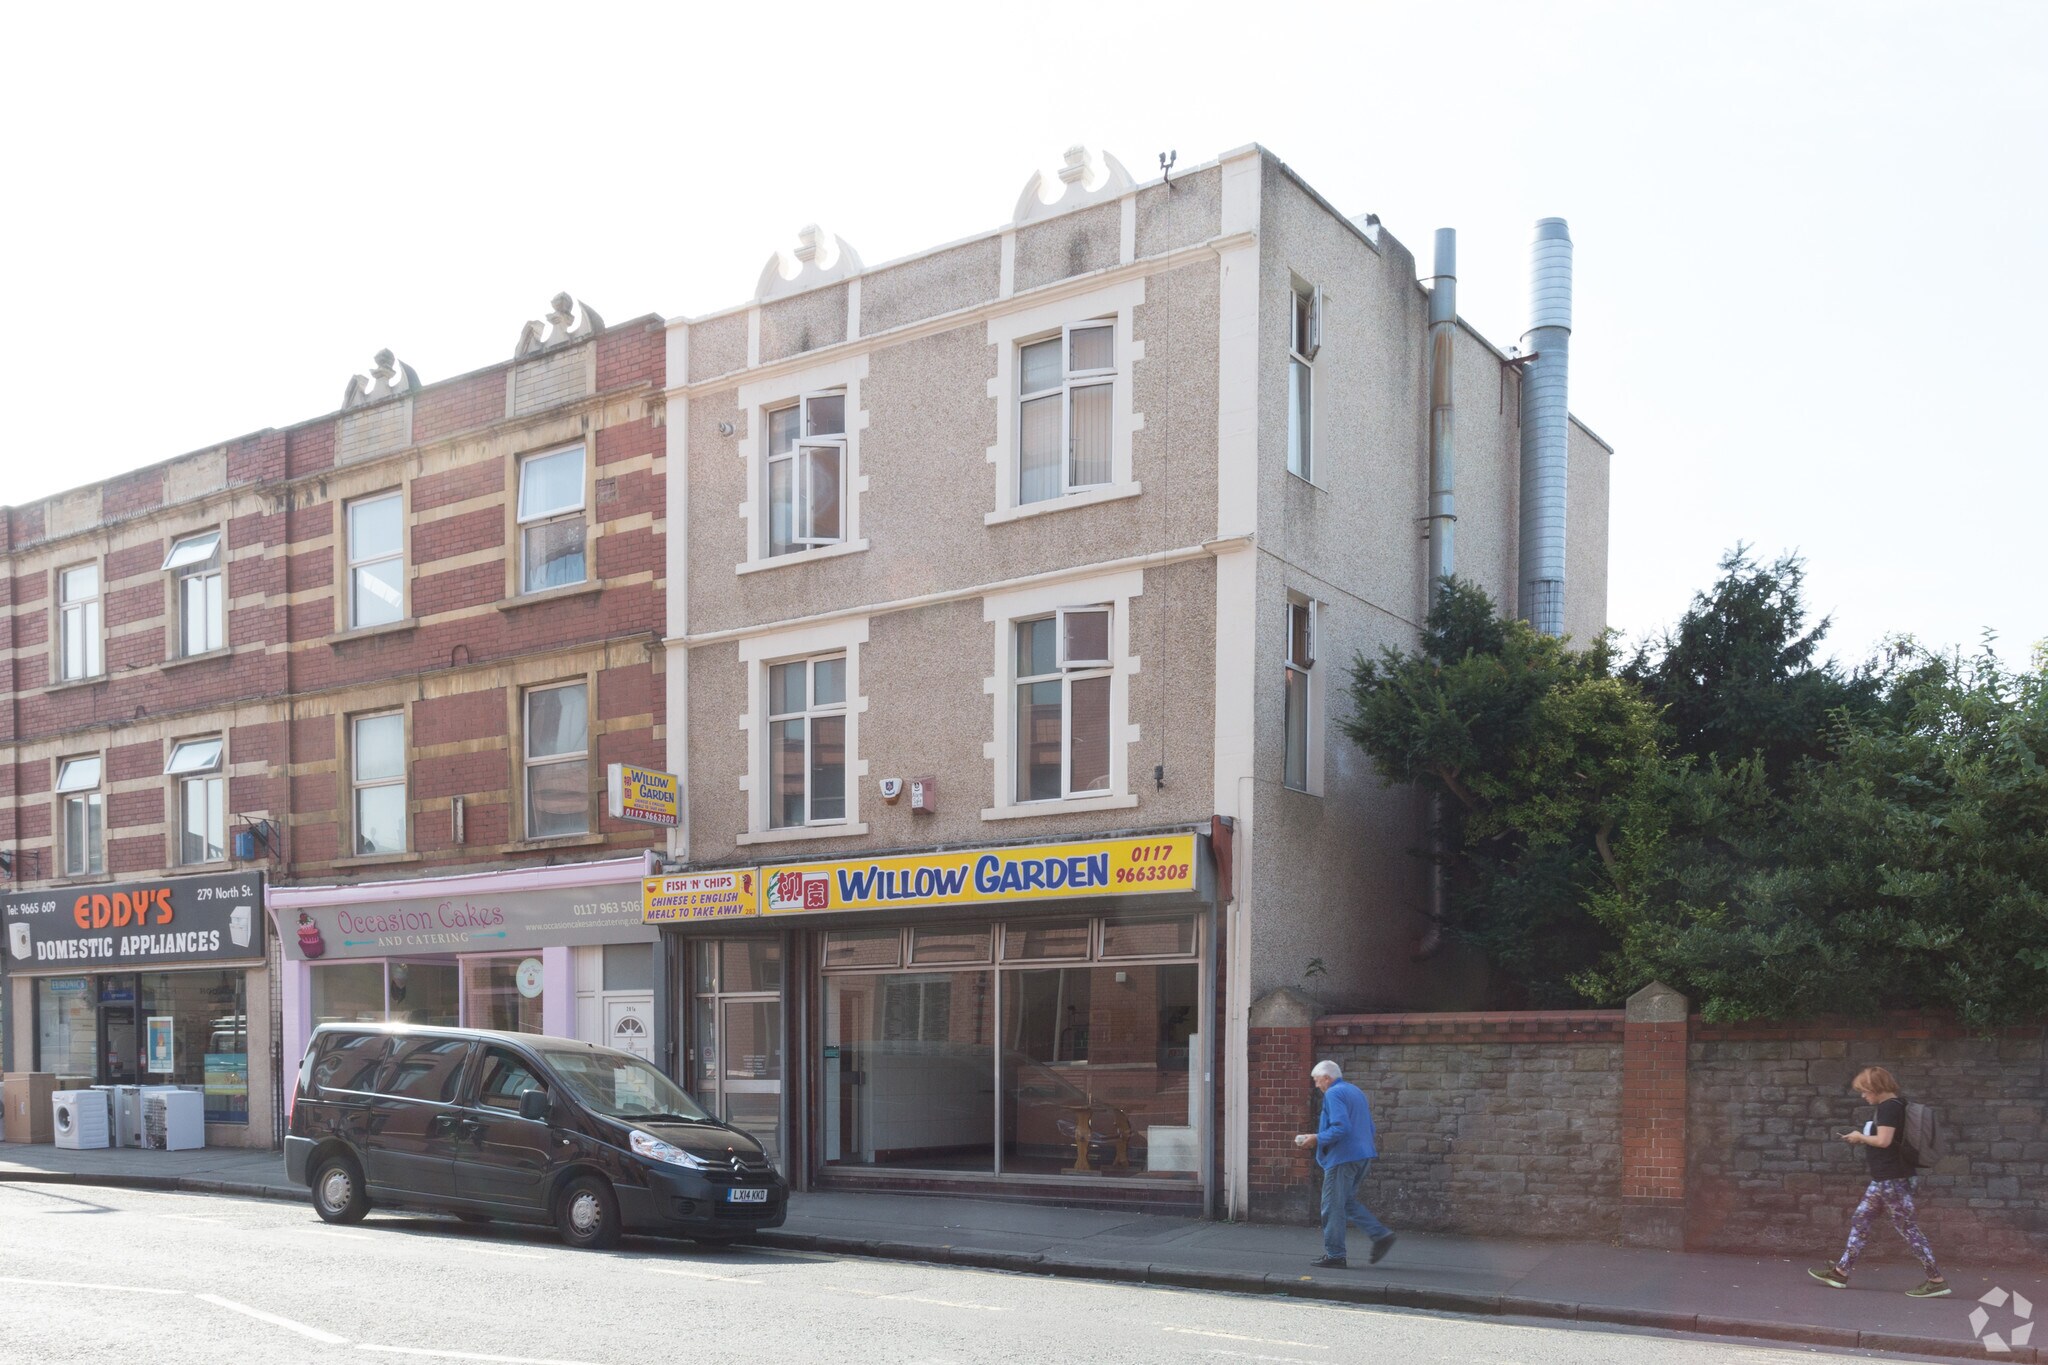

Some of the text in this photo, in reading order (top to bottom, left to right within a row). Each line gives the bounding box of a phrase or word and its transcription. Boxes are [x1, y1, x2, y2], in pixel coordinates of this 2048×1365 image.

[631, 770, 668, 788] WILLOW
[640, 784, 674, 803] GARDEN
[626, 808, 675, 823] 0117 9663308
[1131, 845, 1173, 862] 0117
[837, 853, 1109, 901] WILLOW GARDEN
[1116, 864, 1189, 883] 9663308
[197, 884, 253, 900] 279 North St.
[666, 881, 687, 892] FISH
[704, 877, 732, 888] CHIPS
[20, 902, 39, 914] 9665
[41, 901, 57, 912] 609
[651, 893, 738, 907] CHINESE & ENGLISH
[73, 888, 173, 929] EDDY'S
[573, 904, 597, 915] 0117
[599, 902, 618, 914] 963
[647, 905, 743, 919] MEALS TO TAKE AWAY
[337, 901, 504, 934] Occasion Cakes
[36, 930, 220, 960] DOMESTIC APPLIANCES
[378, 932, 469, 947] AND CATERING
[734, 1190, 765, 1200] LX14 KKD
